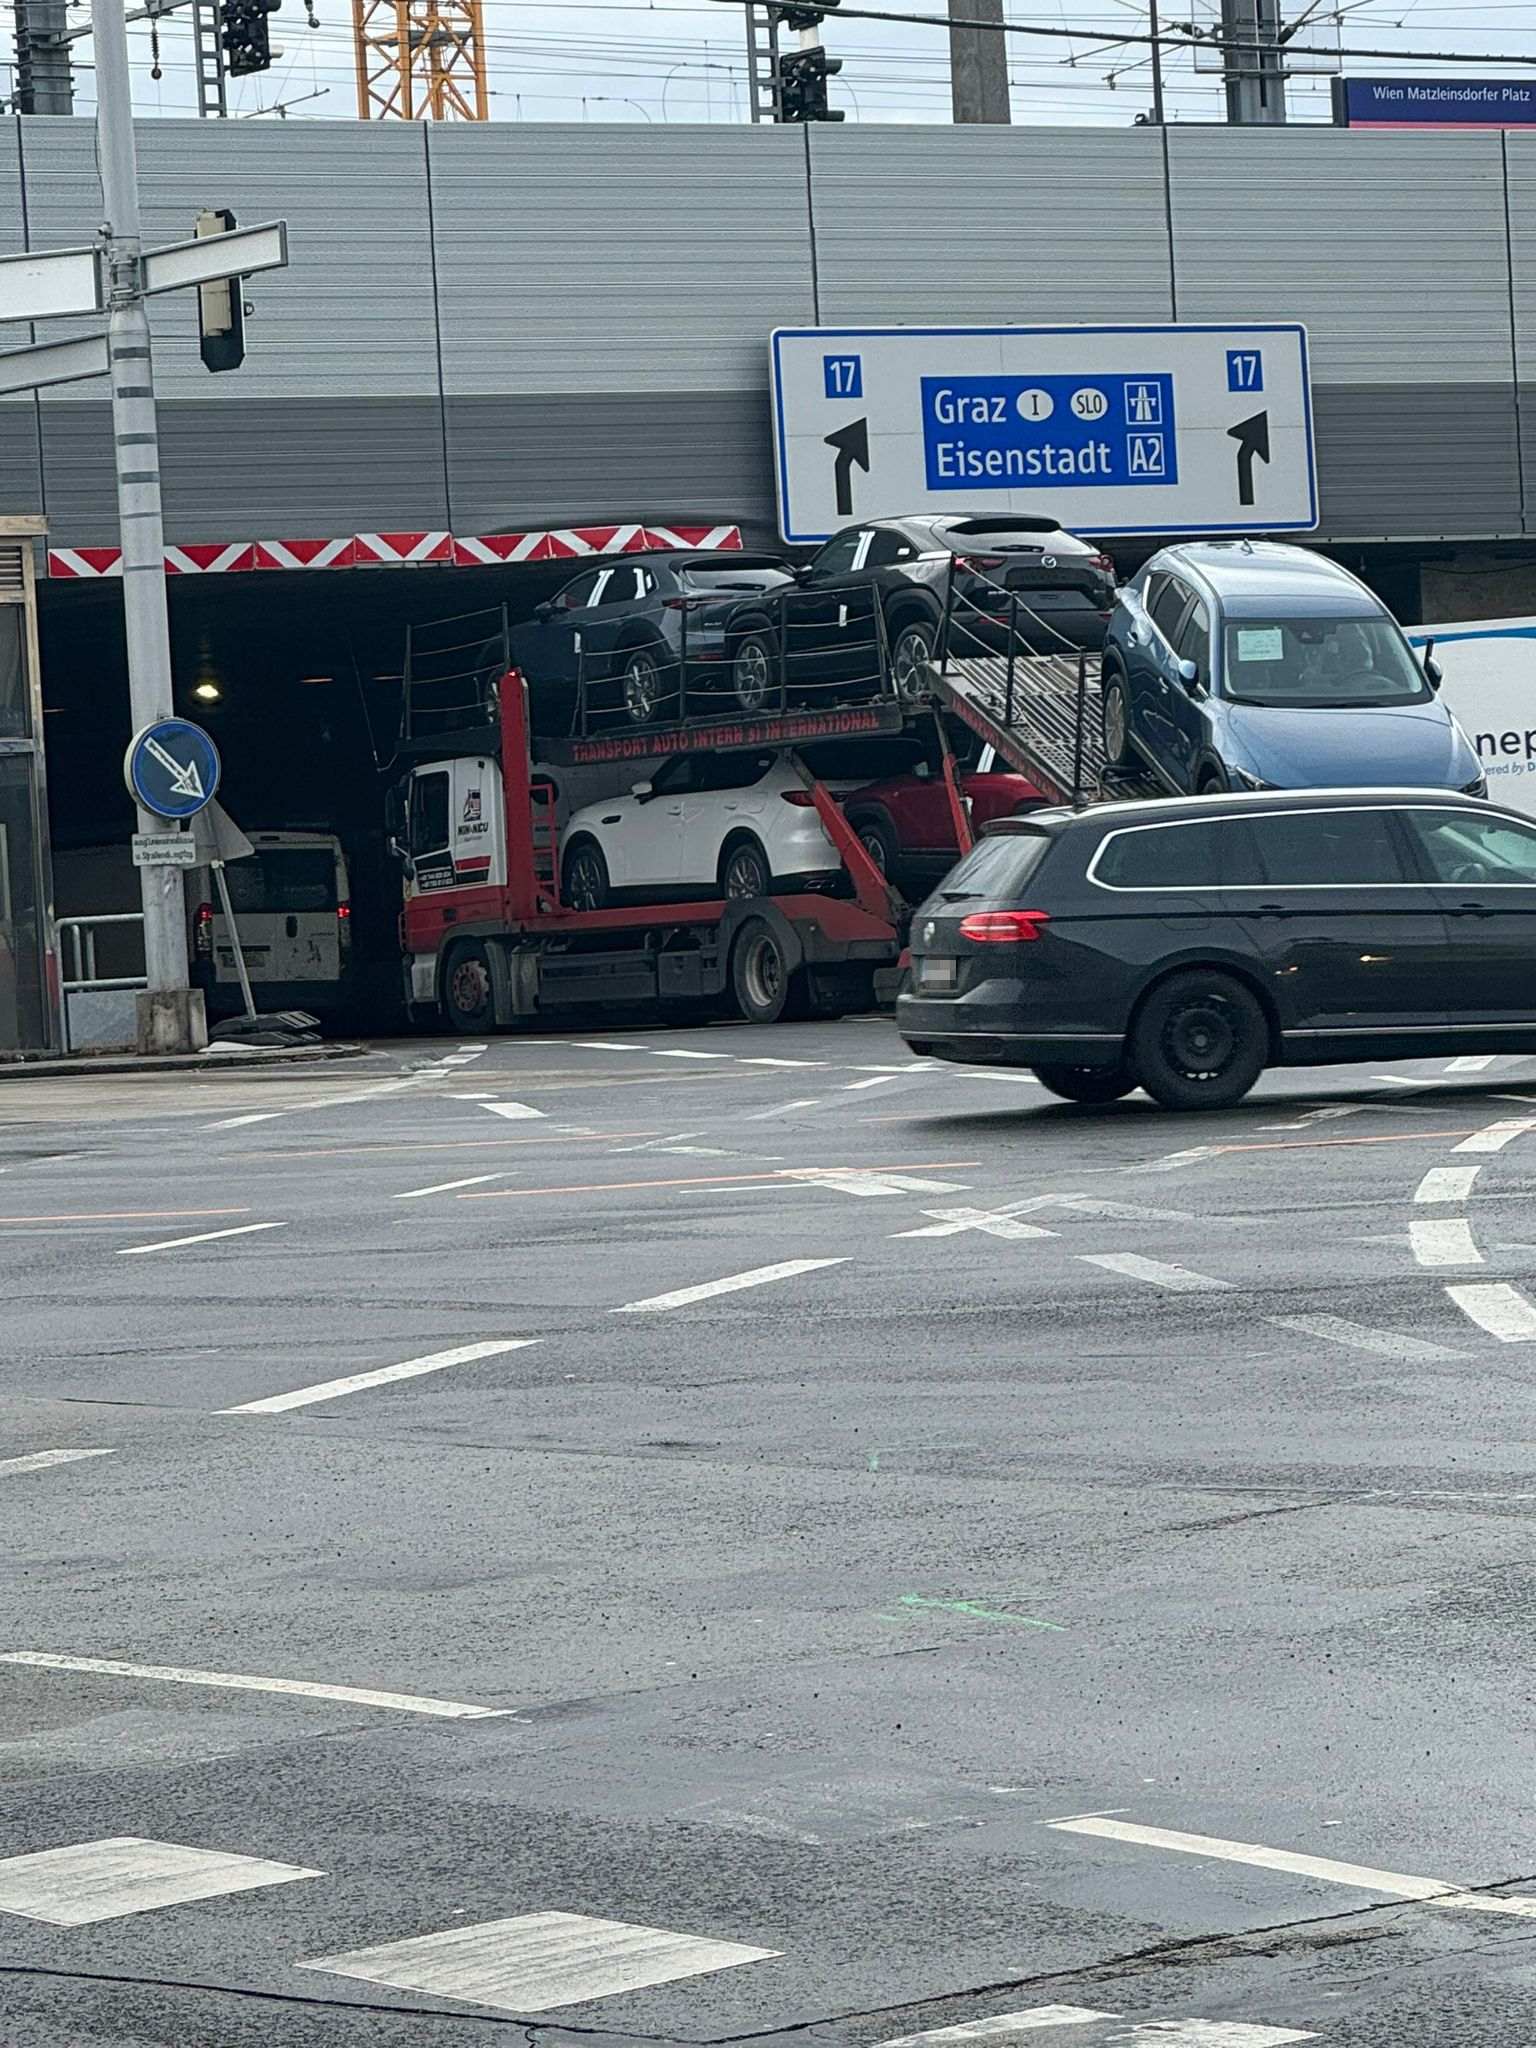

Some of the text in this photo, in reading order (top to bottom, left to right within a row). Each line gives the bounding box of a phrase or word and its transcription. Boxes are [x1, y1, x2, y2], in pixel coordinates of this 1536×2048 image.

[1373, 86, 1531, 101] Wien Matzleinsdorfer Platz
[830, 361, 855, 392] 17
[1232, 355, 1256, 386] 17
[934, 389, 1103, 425] Graz I SLO
[937, 437, 1161, 477] Eisenstadt A2
[572, 737, 647, 762] TRANSPORT
[652, 731, 689, 753] AUTO
[765, 709, 880, 741] INERNATIONAL
[1484, 762, 1509, 776] ered
[1512, 761, 1525, 776] by
